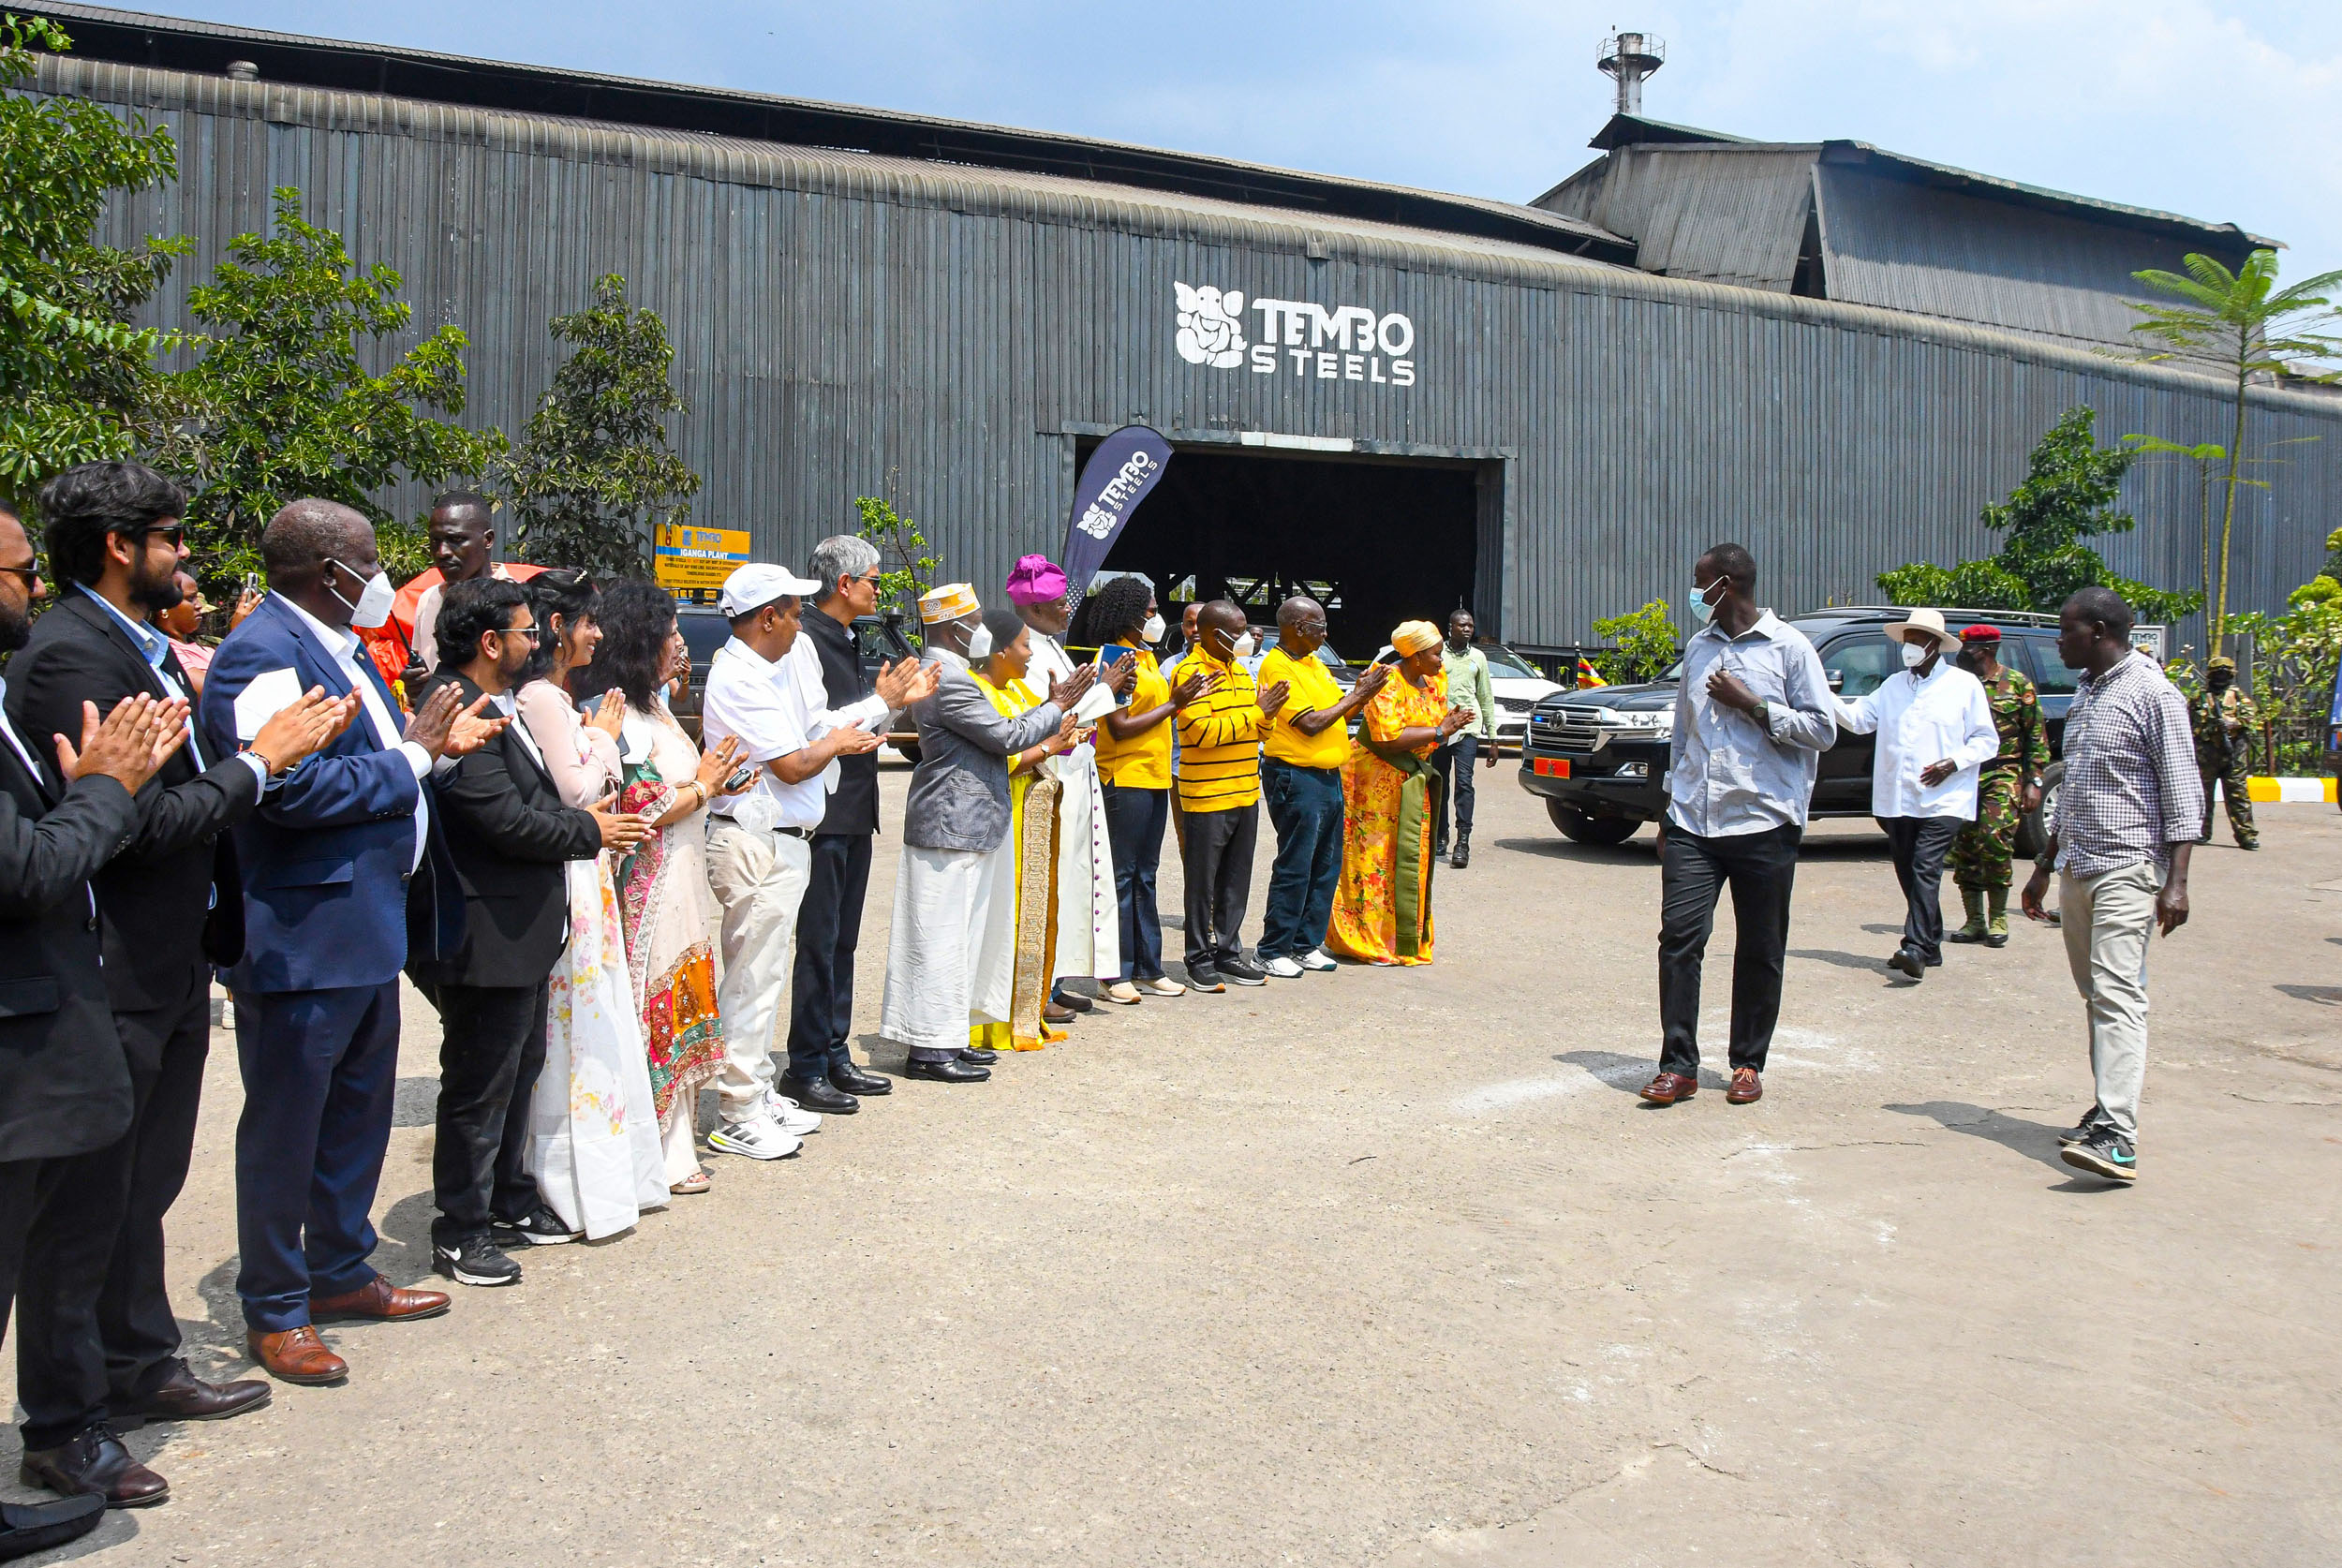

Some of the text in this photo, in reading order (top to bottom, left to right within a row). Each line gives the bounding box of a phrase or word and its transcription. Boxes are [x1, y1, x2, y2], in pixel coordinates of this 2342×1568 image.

[1252, 298, 1415, 357] TEMBO
[1251, 345, 1416, 387] STEELS
[1098, 451, 1149, 506] TEMBO
[1113, 460, 1158, 511] STEELS
[680, 549, 729, 560] IGANGA PLANT
